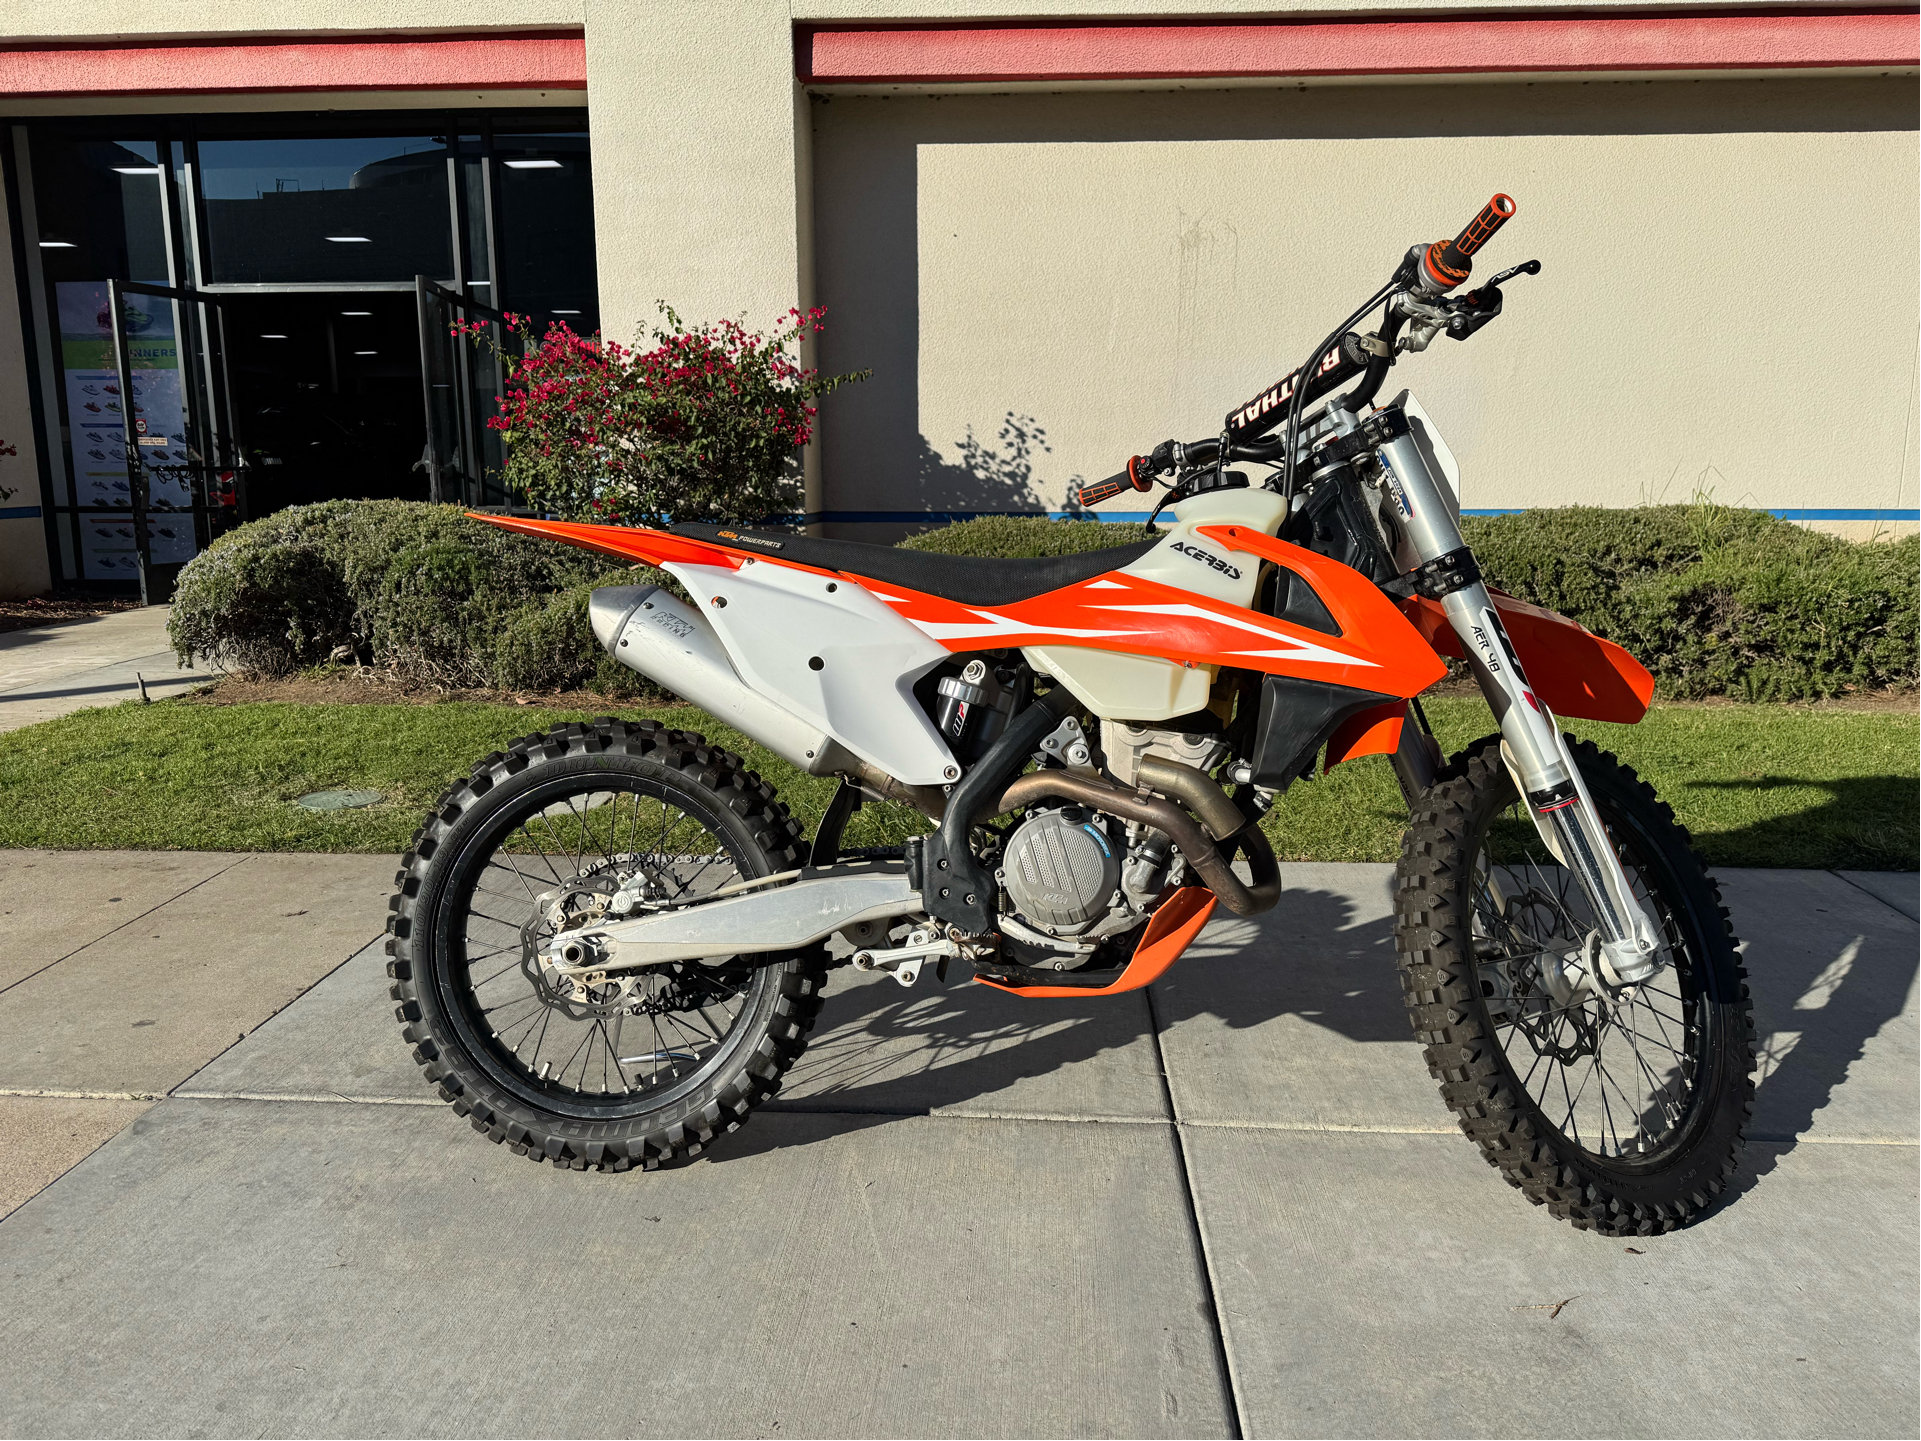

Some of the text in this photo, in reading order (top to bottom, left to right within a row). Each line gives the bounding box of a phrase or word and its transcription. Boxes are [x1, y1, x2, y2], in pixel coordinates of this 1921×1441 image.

[717, 531, 782, 548] KTM POWERPARTS
[650, 611, 696, 636] KTM
[1471, 625, 1501, 673] AER 48
[544, 755, 682, 784] DUNLOP
[1042, 893, 1068, 904] KTM
[524, 1081, 715, 1140] GEOMAX
